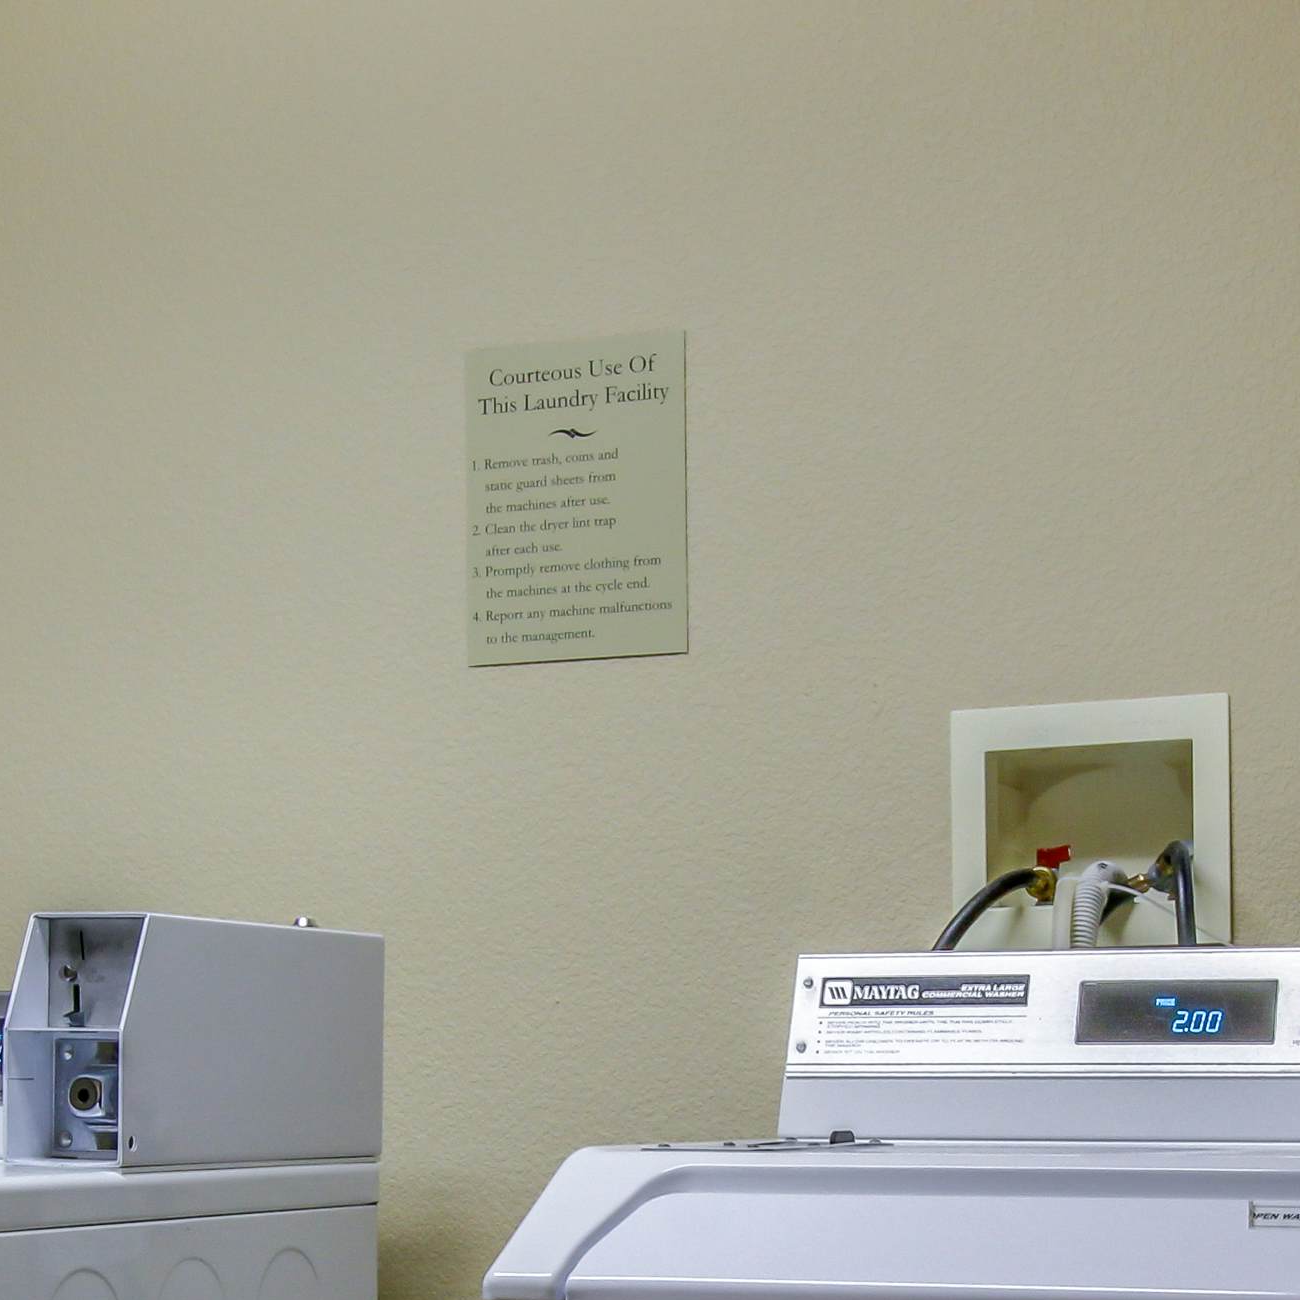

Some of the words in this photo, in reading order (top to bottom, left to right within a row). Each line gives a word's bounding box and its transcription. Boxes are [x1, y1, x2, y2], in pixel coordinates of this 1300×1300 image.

[489, 366, 582, 387] Courteous
[589, 359, 622, 378] Use
[629, 353, 657, 372] Of
[478, 397, 517, 415] This
[524, 389, 598, 411] Laundry
[605, 383, 669, 404] Facility
[485, 458, 528, 470] Remove
[532, 453, 562, 466] trash,
[565, 452, 594, 464] coins
[598, 448, 619, 461] and
[485, 480, 512, 492] static
[516, 476, 547, 492] guard
[551, 475, 585, 486] sheets
[588, 472, 616, 483] from
[486, 503, 501, 514] the
[506, 499, 557, 513] machines
[560, 496, 586, 508] after
[589, 497, 611, 506] use.
[472, 525, 481, 536] 2.
[485, 522, 516, 535] Clean
[519, 520, 536, 532] the
[540, 519, 569, 535] dryer
[572, 517, 590, 529] lint
[594, 516, 617, 530] trap
[485, 545, 511, 557] after
[514, 542, 538, 554] each
[542, 543, 563, 552] use.
[485, 563, 536, 579] Promptly
[540, 563, 580, 573] remove
[584, 557, 630, 572] clothing
[633, 554, 661, 566] from
[486, 587, 504, 599] the
[507, 584, 558, 598] machines
[561, 583, 572, 594] at
[575, 581, 592, 593] the
[595, 578, 623, 592] cycle
[626, 577, 651, 589] end.
[472, 611, 482, 622] 4.
[486, 609, 523, 624] Report
[527, 609, 545, 622] any
[549, 604, 595, 617] machine
[599, 600, 673, 615] malfunctions
[486, 633, 498, 644] to
[501, 631, 518, 643] the
[522, 629, 595, 643] management.
[852, 984, 920, 1000] MAYTAG
[922, 990, 982, 999] COMMERCIAL
[984, 990, 1025, 998] WASHER
[993, 983, 1025, 991] LARGE
[1172, 1010, 1222, 1033] 2.00
